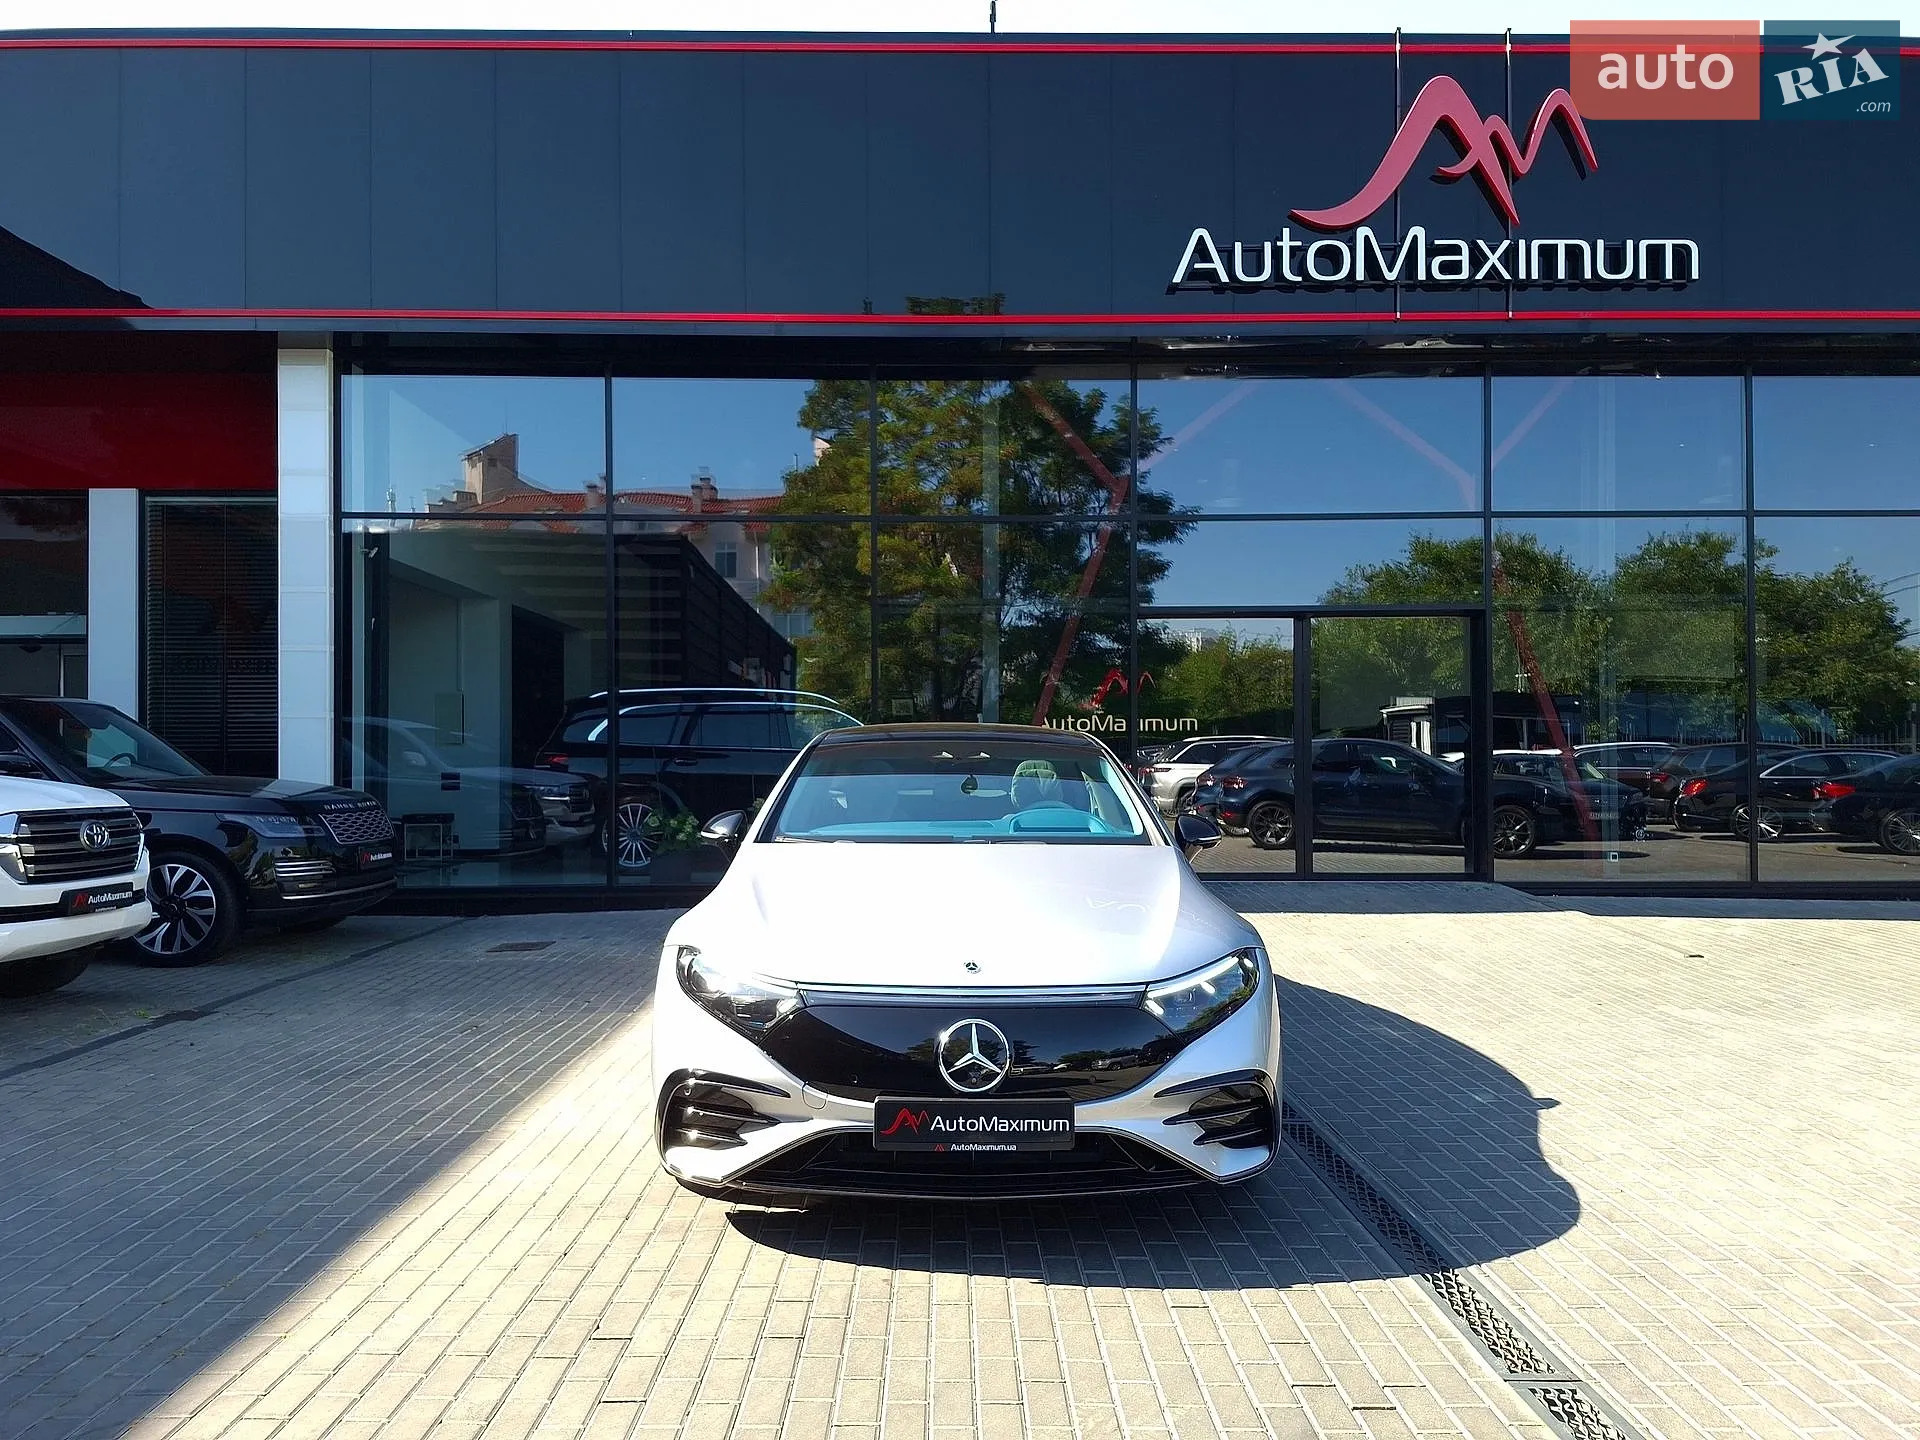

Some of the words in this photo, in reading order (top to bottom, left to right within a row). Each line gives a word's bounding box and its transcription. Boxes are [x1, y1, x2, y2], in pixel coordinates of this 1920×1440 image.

[1171, 226, 1700, 284] AutoMaximum
[930, 1115, 1070, 1132] AutoMaximum
[950, 1143, 1017, 1151] AutoMaximum.ua
